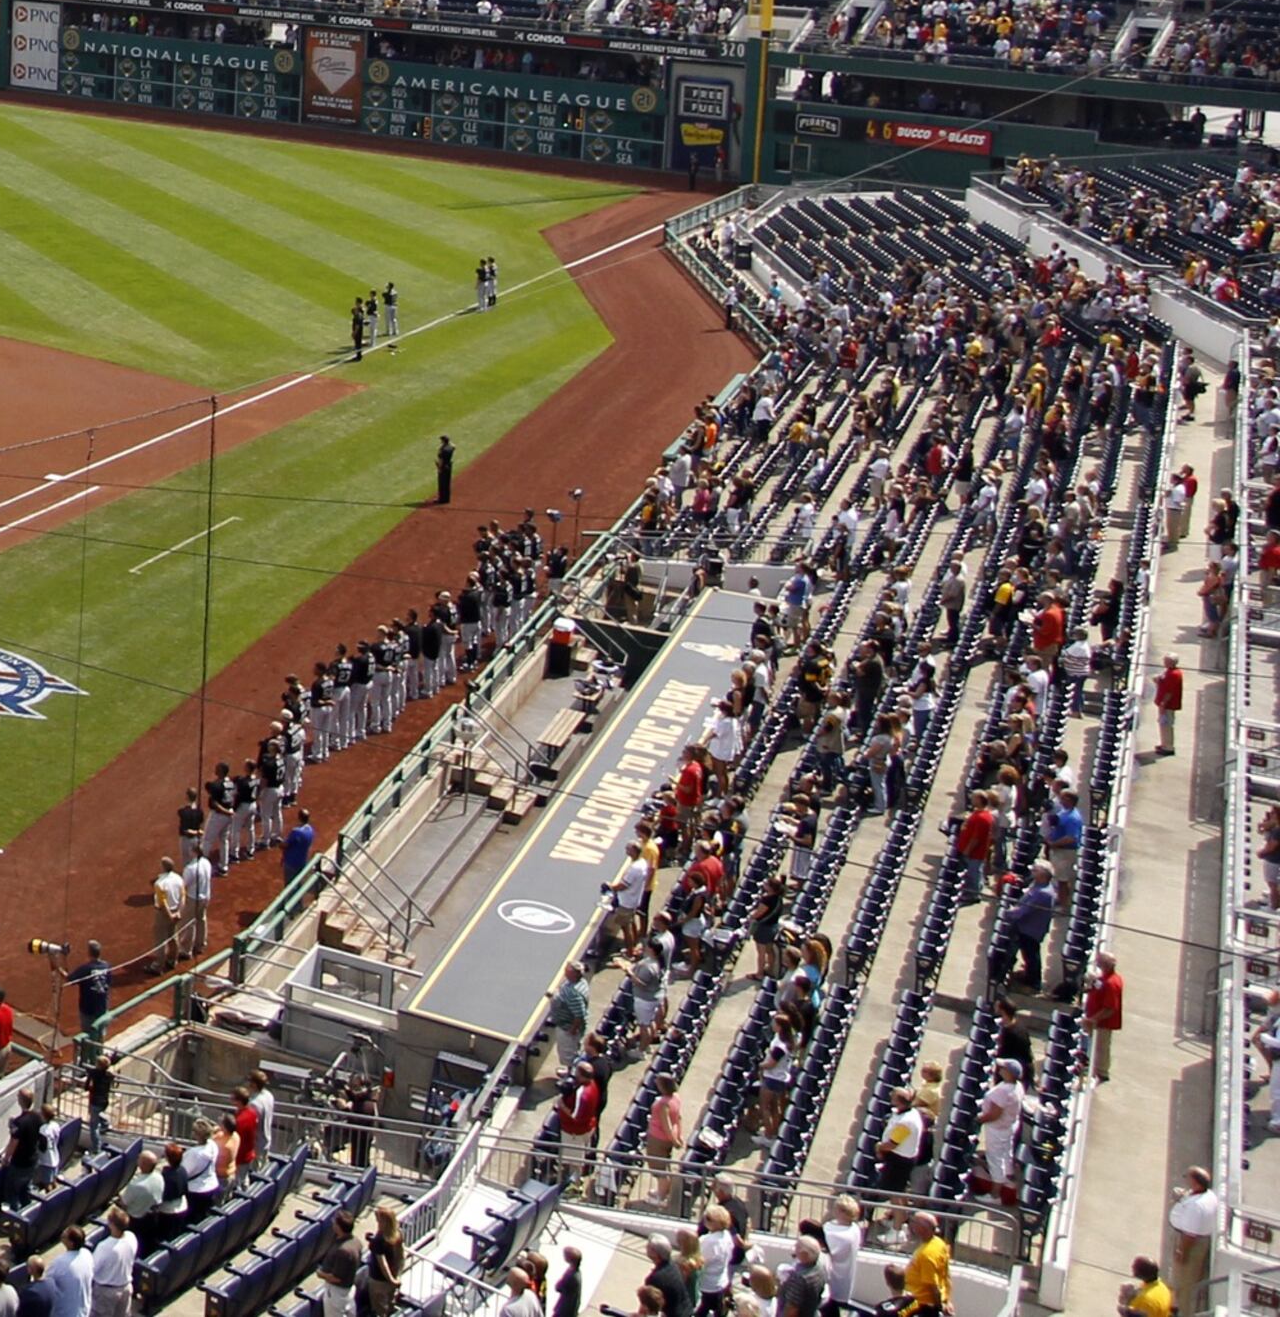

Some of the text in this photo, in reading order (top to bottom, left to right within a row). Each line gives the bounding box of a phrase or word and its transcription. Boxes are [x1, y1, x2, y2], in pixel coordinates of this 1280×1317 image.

[173, 2, 205, 12] CONSOL
[30, 9, 58, 24] PNC
[338, 16, 374, 27] CONSOL
[28, 38, 58, 53] PNC
[526, 33, 566, 45] CONSOL
[609, 41, 641, 52] AMERICA'S
[642, 43, 665, 54] ENERGY
[720, 41, 745, 57] 320
[83, 42, 269, 71] NATIONAL LEAGUE
[27, 67, 57, 82] PNC
[394, 75, 627, 111] AMERICAN LEAGUE
[691, 88, 723, 100] FREE
[691, 103, 723, 115] FUEL
[798, 117, 837, 132] PIRATES
[896, 126, 986, 146] BUCCO BLASTS
[538, 142, 553, 154] TEX
[616, 152, 633, 164] SEA
[549, 679, 711, 865] WELCOME TO PNC PARK
